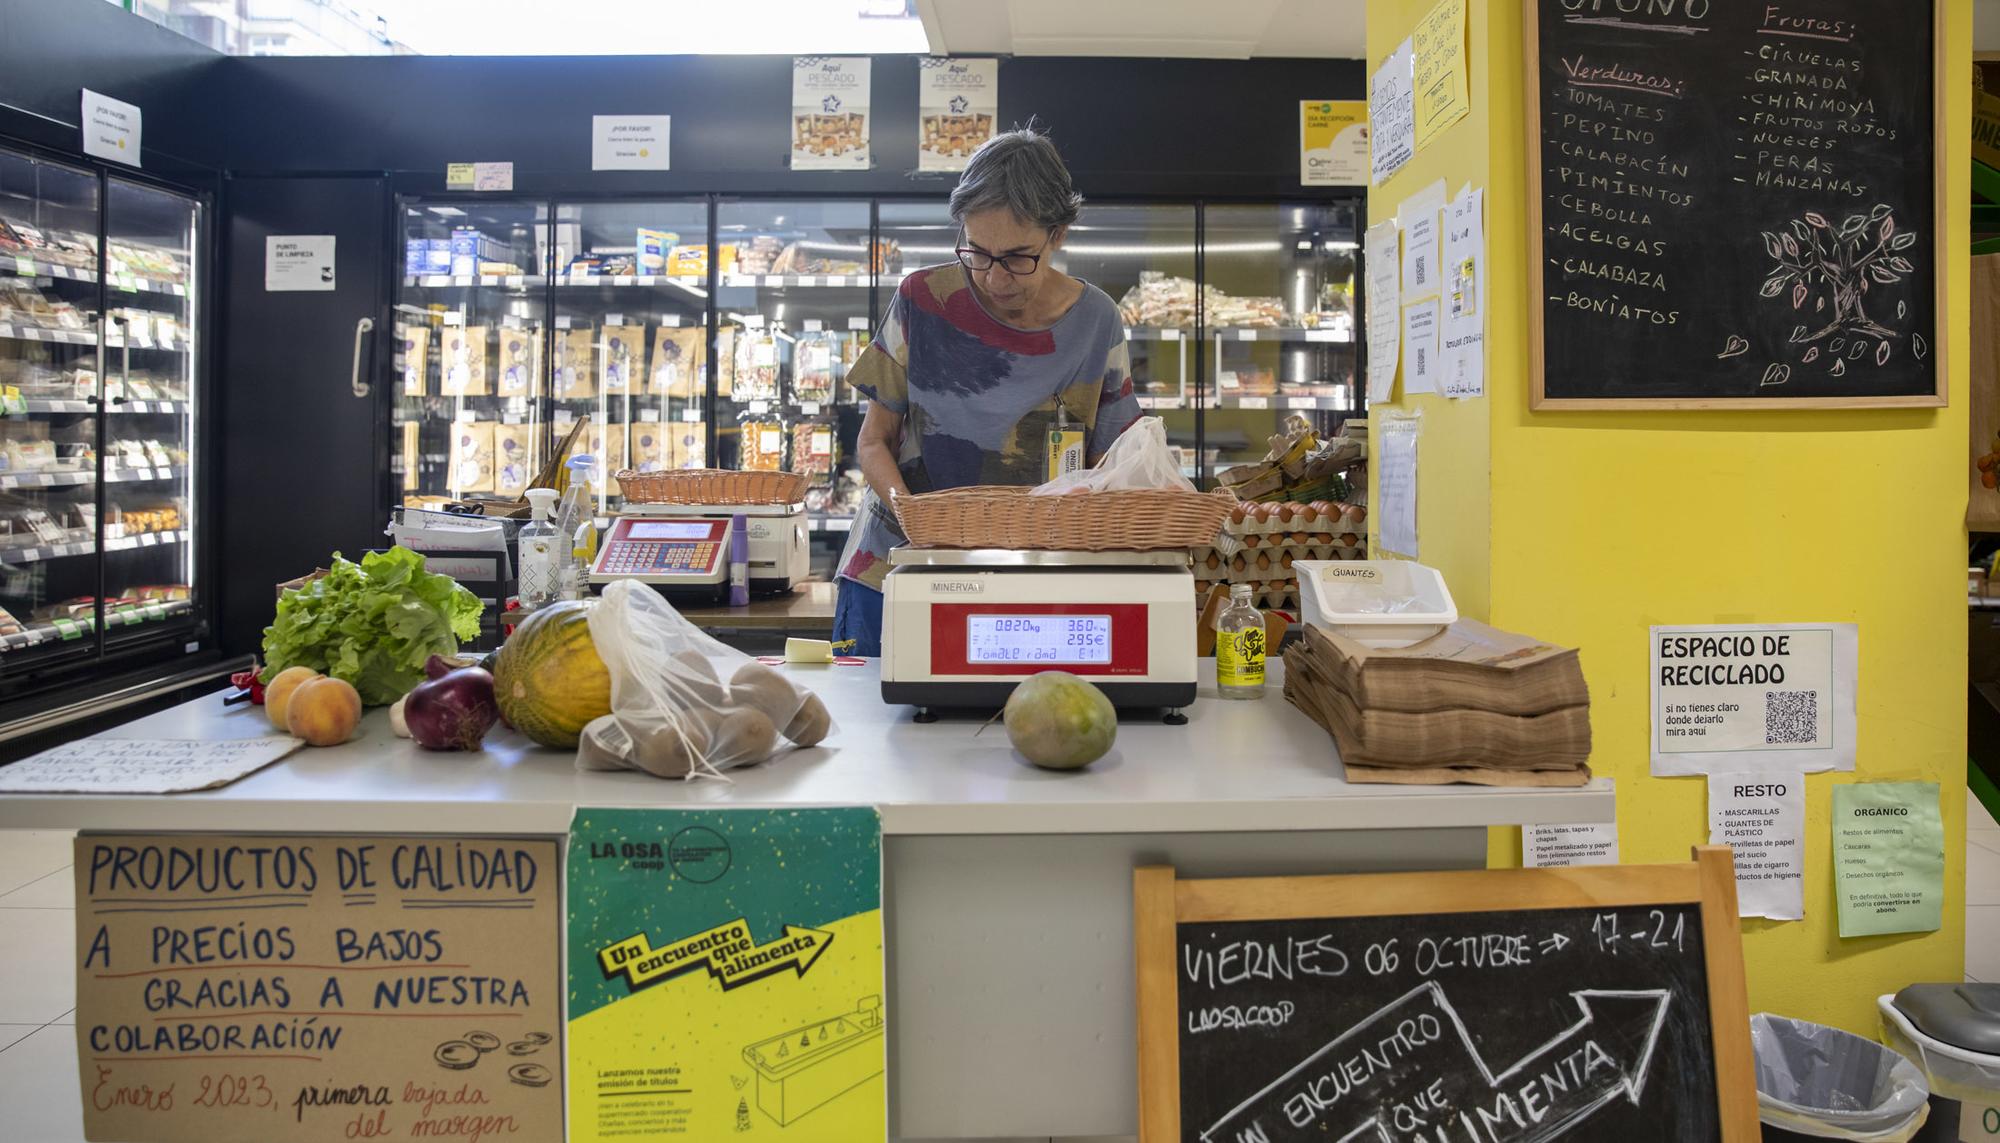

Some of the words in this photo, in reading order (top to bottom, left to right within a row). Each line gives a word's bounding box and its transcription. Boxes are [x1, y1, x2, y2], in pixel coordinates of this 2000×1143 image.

[1763, 5, 1855, 38] Frutas:
[1759, 43, 1861, 71] CIRUELAS
[809, 73, 855, 83] PESCADO
[936, 74, 983, 83] PESCADO
[1562, 55, 1683, 93] Verduras:
[1755, 69, 1846, 90] GRANADA
[1568, 88, 1666, 121] TOMATES
[1751, 91, 1874, 116] CHIRIMOYA
[1564, 114, 1654, 144] PEPINO
[1753, 112, 1823, 130] FRUTOS
[1837, 118, 1896, 140] ROJOS
[1753, 132, 1837, 149] NUECES
[1562, 142, 1687, 177] CALABACÍN
[1758, 151, 1833, 174] PERAS
[1561, 167, 1693, 206] PIMIENTOS
[1756, 171, 1867, 196] MANZANAS
[1561, 194, 1652, 224] CEBOLLA
[1560, 222, 1666, 256] ACELGAS
[1564, 259, 1666, 291] CALABAZA
[1567, 292, 1679, 324] BONIATOS
[1333, 567, 1375, 578] GUANTES
[1661, 636, 1755, 658] ESPACIO
[1763, 635, 1790, 656] DE
[1661, 663, 1785, 686] RECICLADO
[1666, 703, 1673, 713] si
[1676, 704, 1686, 713] no
[1689, 702, 1715, 713] tienes
[1717, 702, 1739, 712] claro
[1666, 715, 1691, 725] donde
[1694, 714, 1724, 725] dejarlo
[1666, 727, 1686, 736] mira
[1688, 726, 1706, 737] aquí
[1734, 784, 1787, 798] RESTO
[1725, 808, 1780, 816] MASCARILLAS
[1854, 806, 1908, 816] ORGÁNICO
[1725, 820, 1762, 828] GUANTES
[1725, 828, 1763, 837] PLÁSTICO
[591, 842, 617, 858] LA
[622, 843, 663, 858] OSA
[1774, 838, 1795, 847] papel
[1733, 851, 1745, 859] pel
[1764, 861, 1789, 870] cigarro
[89, 845, 317, 895] PRODUCTOS
[337, 846, 376, 890] DE
[1774, 872, 1801, 880] higiene
[1873, 898, 1910, 906] convertirse
[84, 924, 110, 968] A
[336, 928, 442, 963] BAJOS
[609, 943, 643, 965] Un
[637, 926, 743, 974] encuentro
[712, 937, 751, 963] que
[723, 934, 816, 977] alimenta
[1185, 932, 1349, 989] VIERNES
[1365, 938, 1399, 976] 06
[1416, 934, 1531, 975] OCTUBRE
[144, 977, 291, 1011] GRACIAS
[320, 977, 344, 1008] A
[374, 976, 530, 1008] NUESTRA
[598, 1069, 644, 1078] Lanzamos
[647, 1066, 681, 1075] nuestra
[598, 1078, 634, 1088] emisión
[637, 1078, 647, 1086] de
[649, 1076, 679, 1086] títulos
[1283, 1014, 1441, 1128] ENCUENTRO
[93, 1065, 175, 1111] Enero
[194, 1074, 278, 1111] 2023,
[294, 1079, 392, 1122] primera
[403, 1081, 489, 1117] bajada
[1393, 1077, 1448, 1132] QUE
[346, 1110, 392, 1138] del
[411, 1113, 519, 1143] margen
